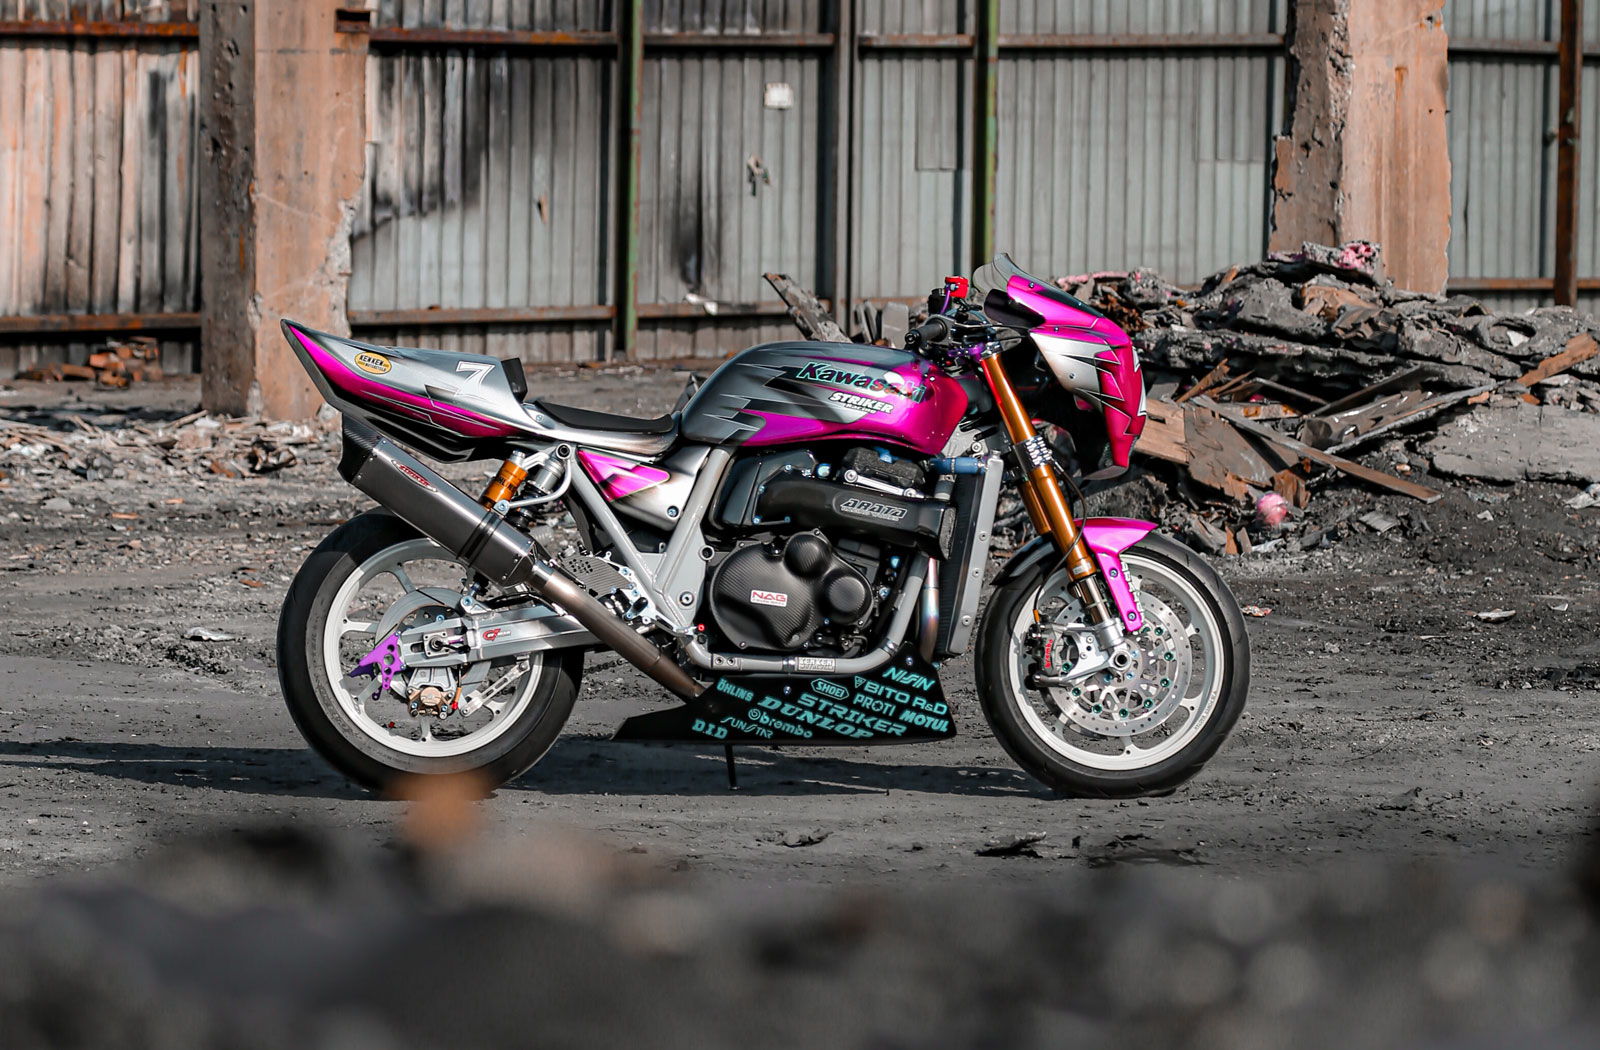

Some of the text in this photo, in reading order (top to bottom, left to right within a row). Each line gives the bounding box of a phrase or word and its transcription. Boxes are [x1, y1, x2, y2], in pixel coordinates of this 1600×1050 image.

[454, 360, 496, 397] 7
[796, 362, 927, 404] Kawasaki
[828, 391, 894, 414] STRIKER
[840, 498, 907, 519] ARATA
[752, 591, 786, 602] NAG
[815, 680, 845, 698] SHOEI
[864, 681, 910, 703] BITO
[912, 696, 948, 715] R&D
[757, 696, 874, 738] DUNLOP
[797, 693, 907, 736] STRIKER
[853, 693, 896, 717] PROTI
[759, 711, 813, 738] brembo
[899, 710, 949, 733] MOTUL
